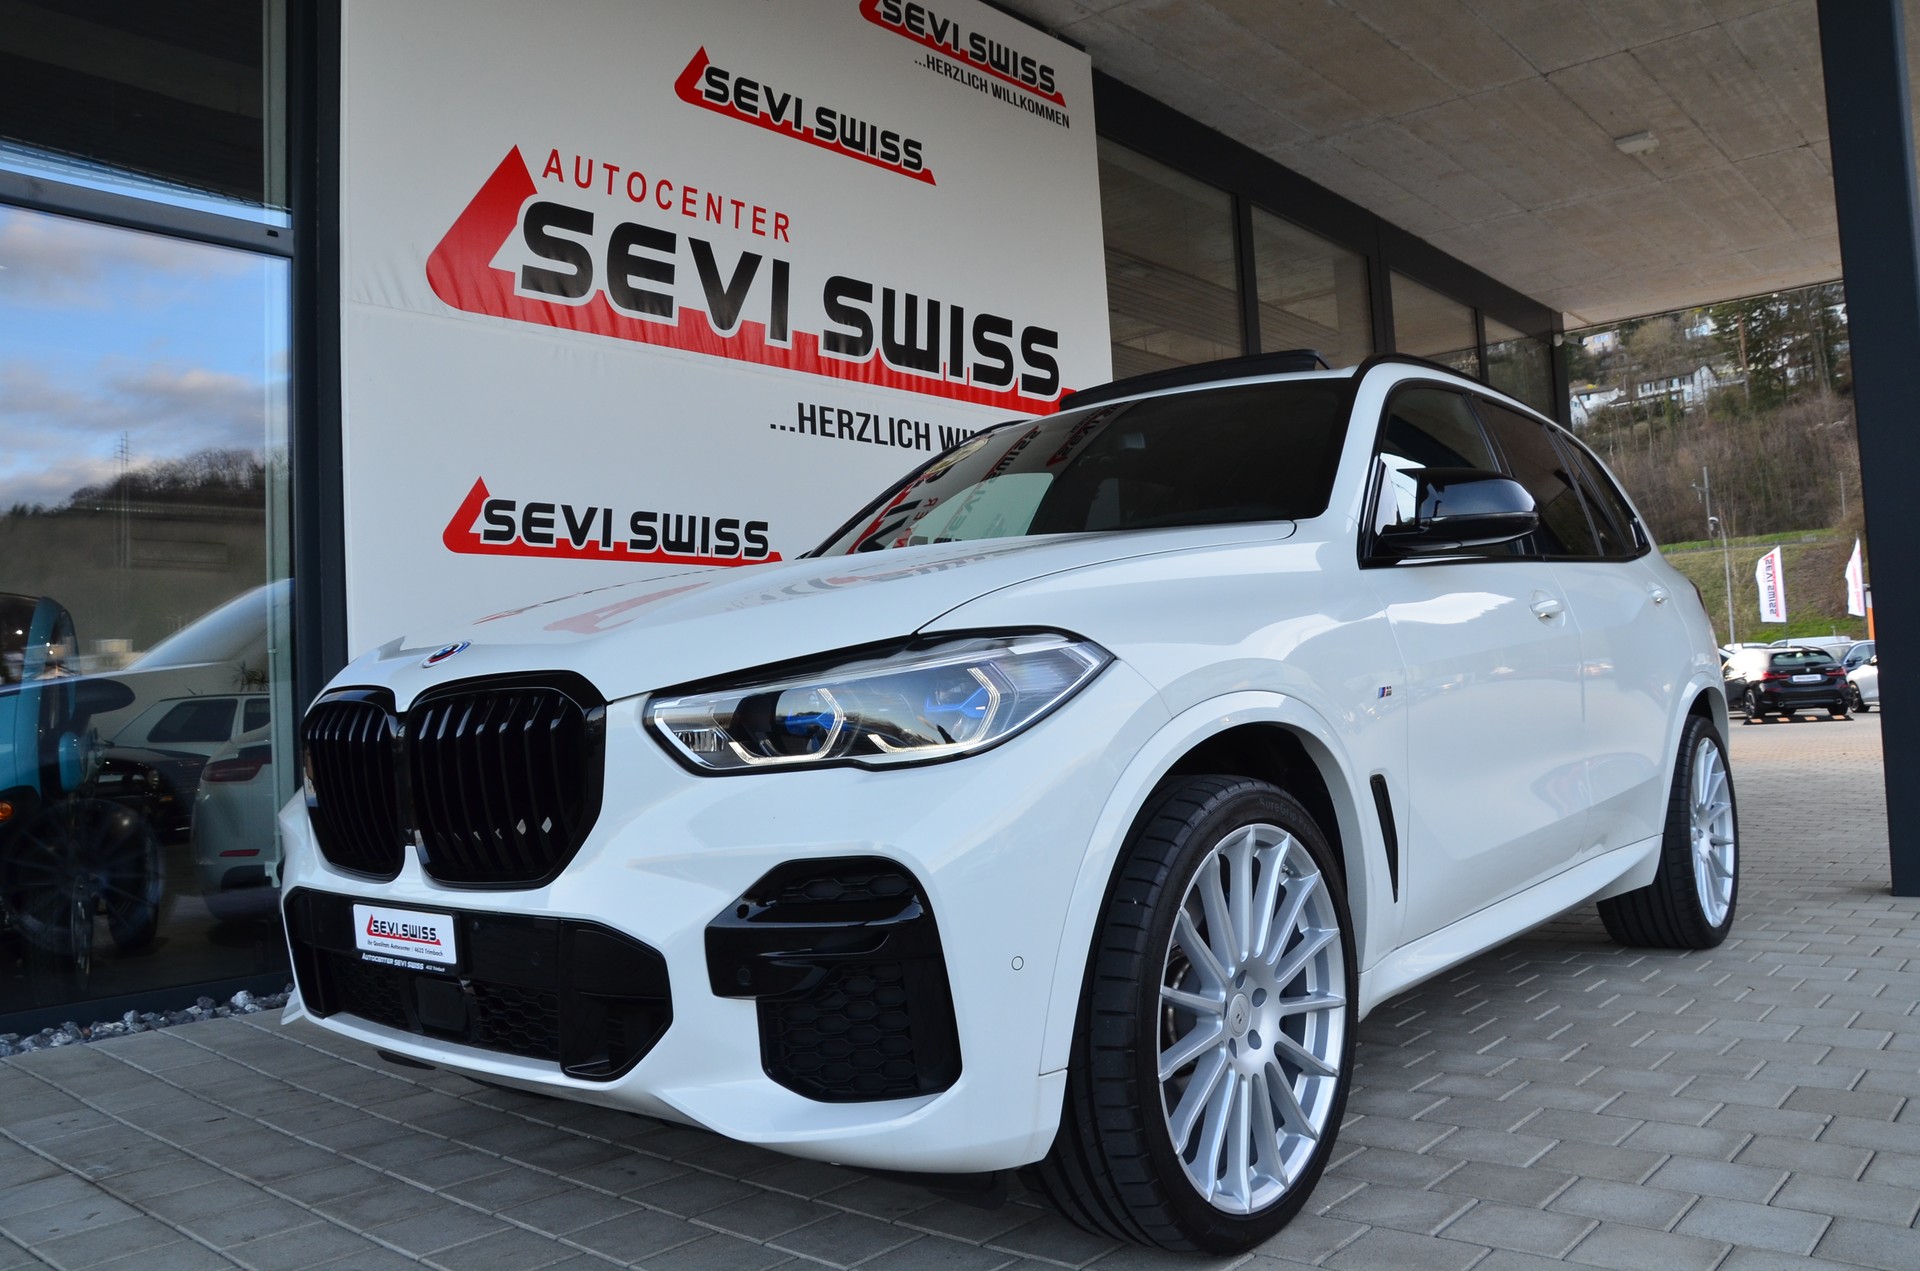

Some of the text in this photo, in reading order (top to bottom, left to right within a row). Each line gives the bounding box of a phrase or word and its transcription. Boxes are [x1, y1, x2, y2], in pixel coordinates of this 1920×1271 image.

[881, 0, 1056, 94] SEVI SWISS
[704, 66, 922, 172] SEVI SWISS
[991, 81, 1070, 129] WILLKOMMEN
[542, 148, 790, 243] AUTOCENTER
[521, 201, 1060, 396] SEVI SWISS
[483, 498, 769, 558] SEVI SWISS
[372, 919, 437, 941] SEVI SWISS
[394, 959, 407, 967] SEVI
